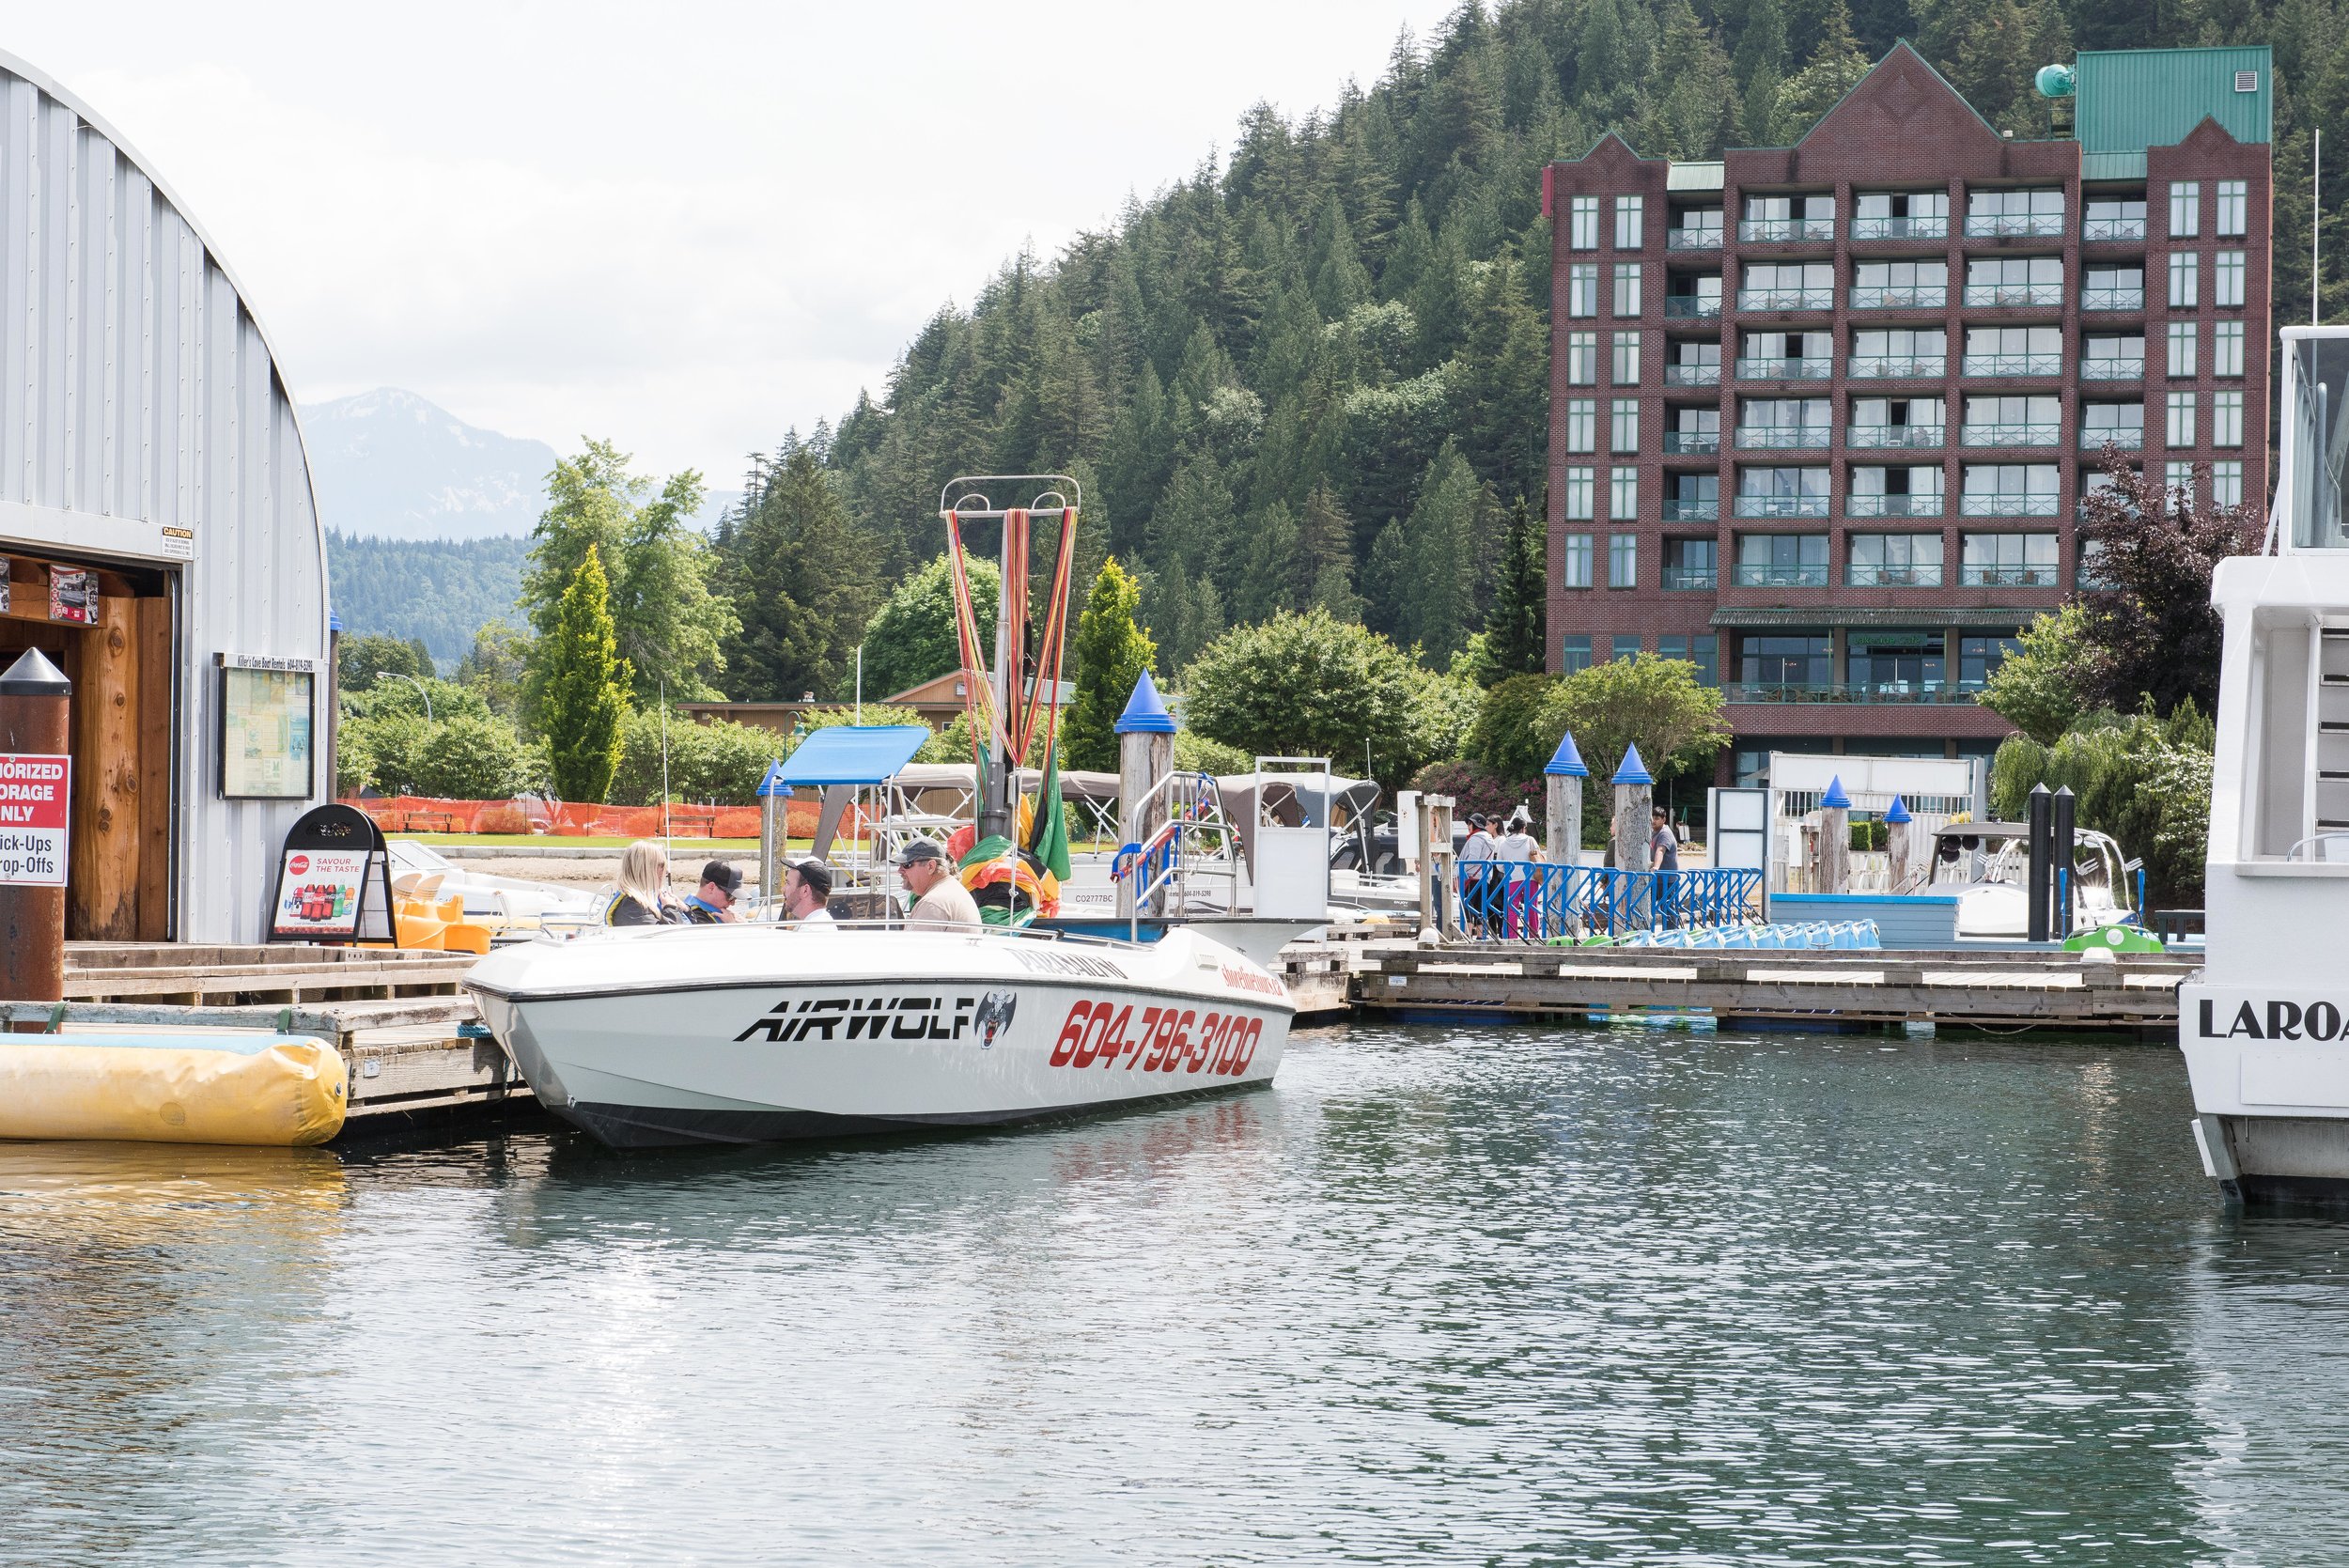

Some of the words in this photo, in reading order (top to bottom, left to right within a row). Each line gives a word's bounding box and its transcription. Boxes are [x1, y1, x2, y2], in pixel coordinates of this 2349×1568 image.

[163, 527, 192, 538] CAUTION
[262, 657, 271, 669] Boat
[272, 658, 286, 670] Rentals
[0, 762, 64, 780] ORIZED
[732, 997, 974, 1042] AIRWOLF
[2199, 999, 2349, 1042] LARO
[1049, 1000, 1263, 1077] 604-796-3100
